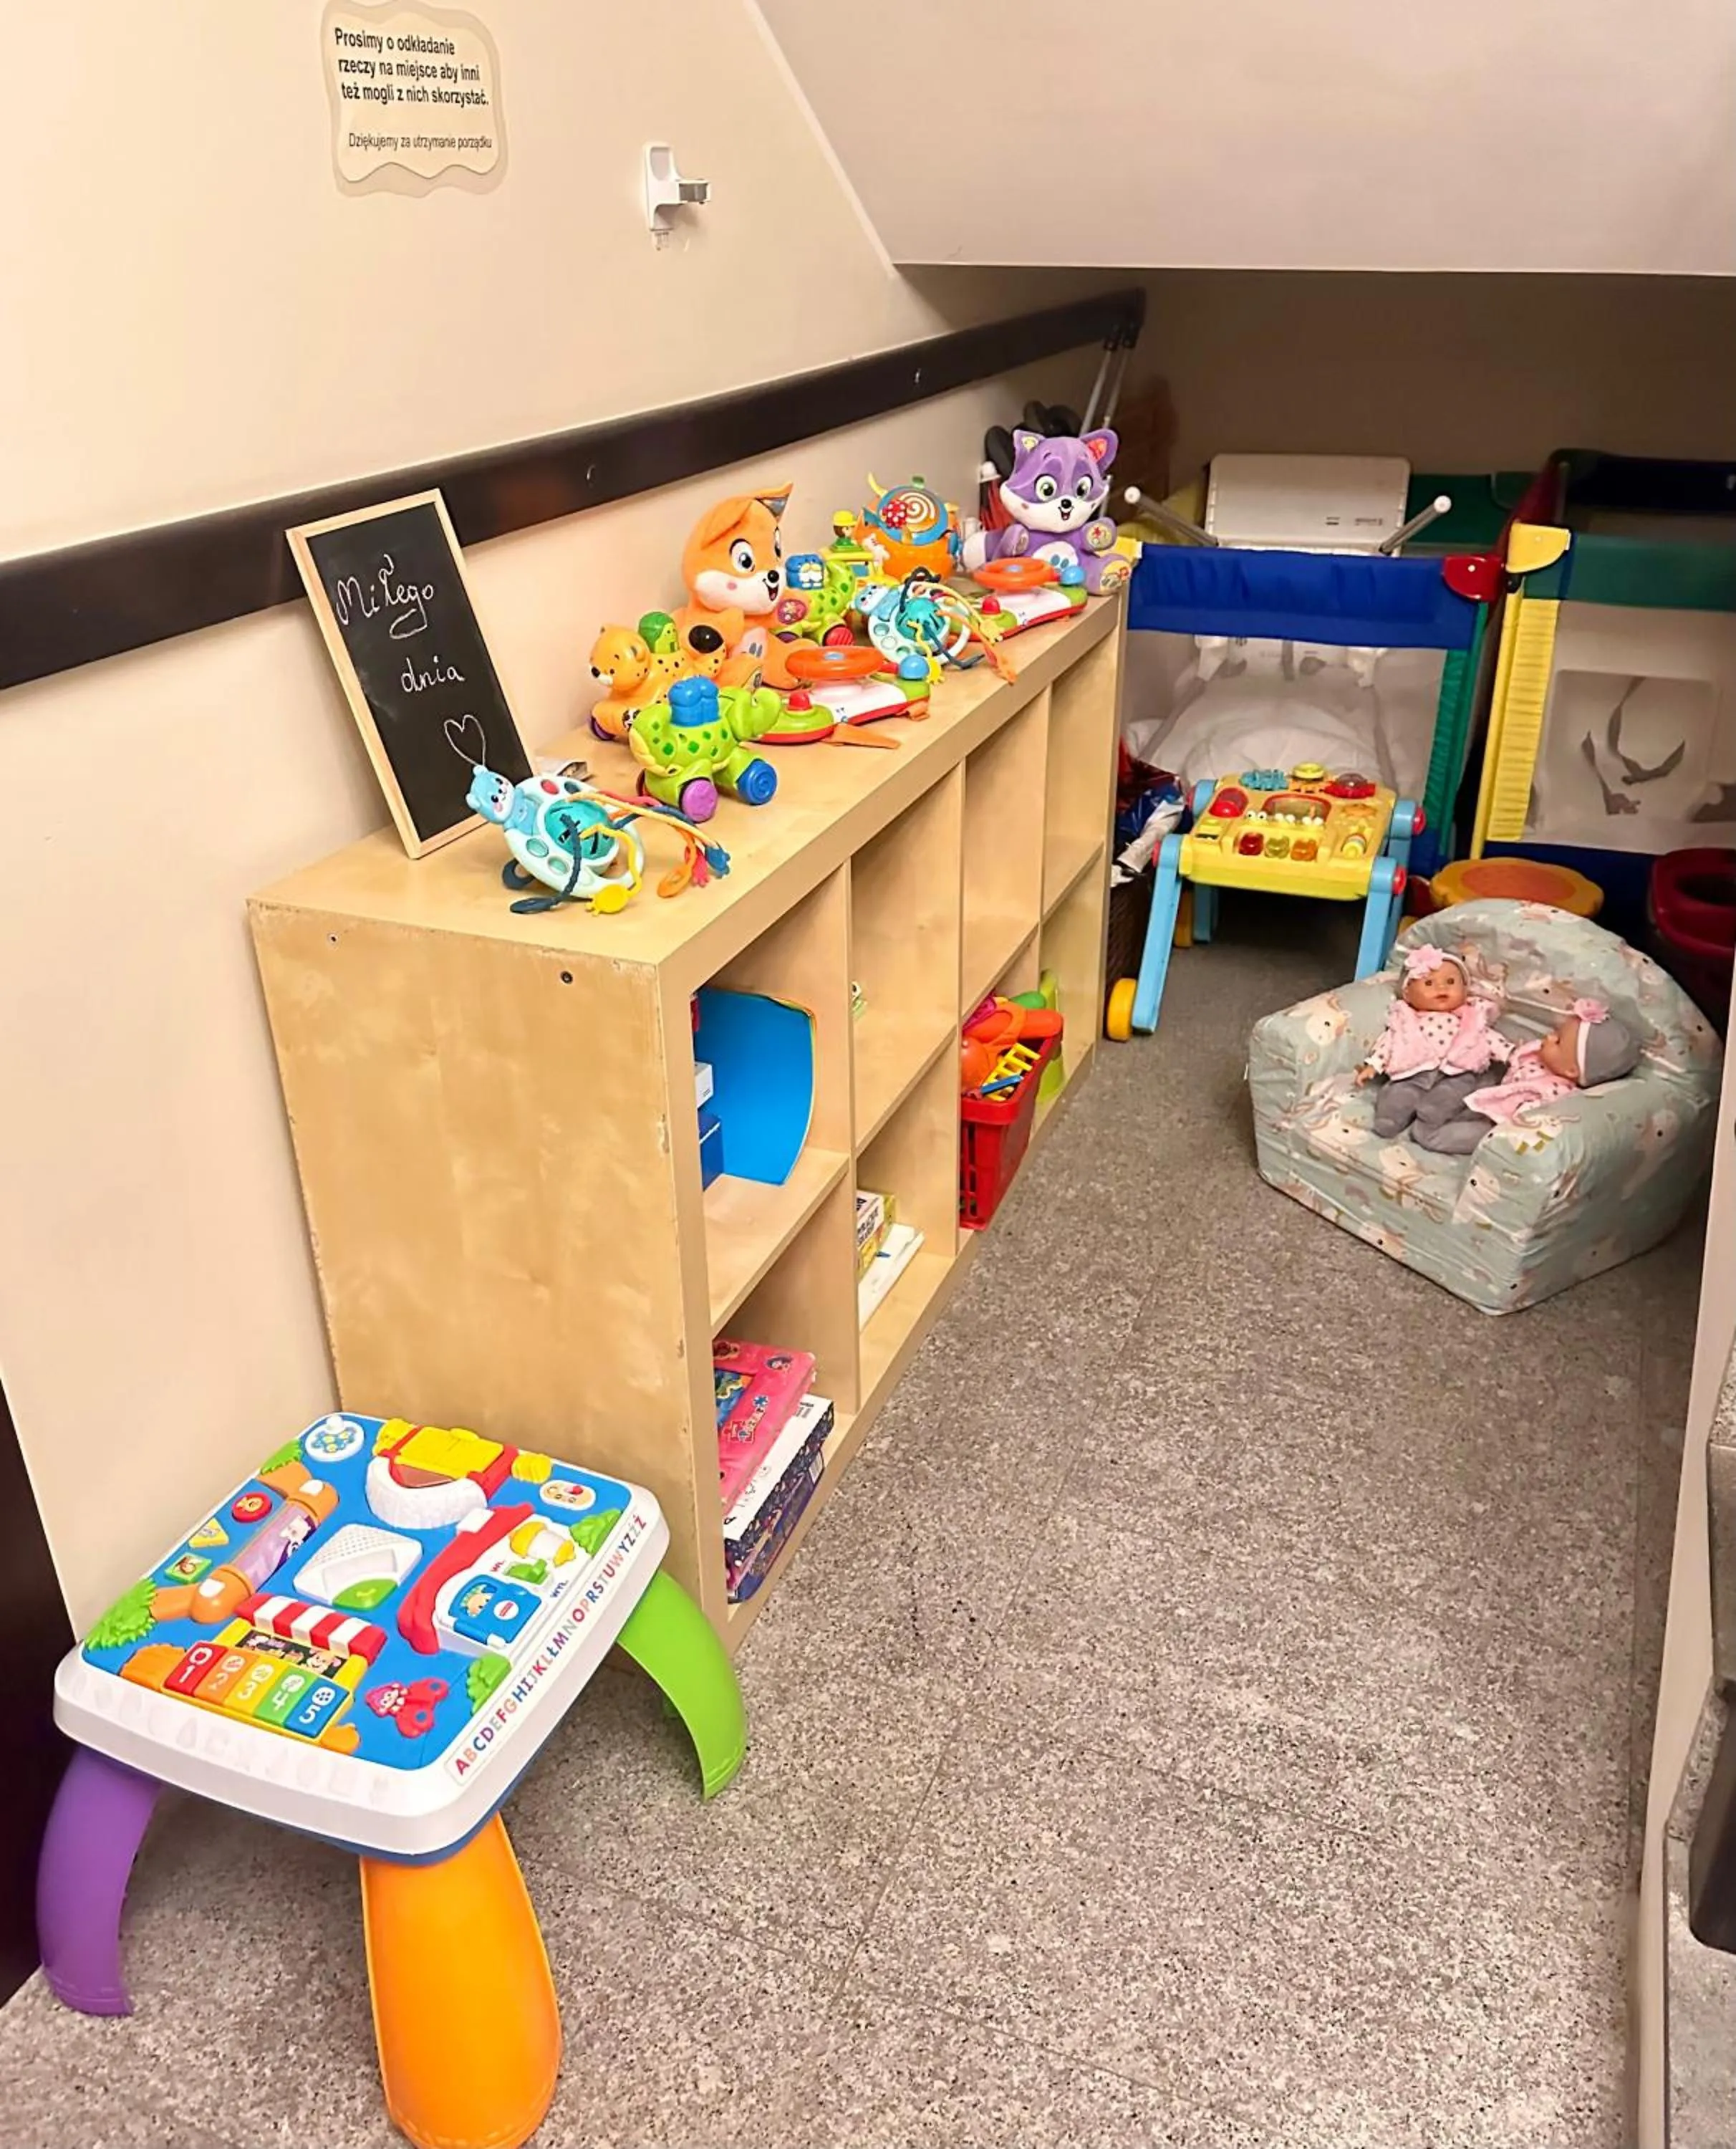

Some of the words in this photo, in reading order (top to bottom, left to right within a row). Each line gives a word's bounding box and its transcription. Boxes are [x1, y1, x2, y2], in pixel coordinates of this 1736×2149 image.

[334, 27, 382, 53] Prosimy
[387, 37, 395, 50] o
[397, 35, 455, 55] odkładanie
[338, 59, 376, 79] rzeczy
[380, 62, 393, 76] na
[396, 60, 438, 81] miejsce
[440, 63, 458, 84] aby
[460, 64, 481, 81] inni
[342, 82, 360, 100] też
[363, 84, 395, 105] mogli
[397, 88, 404, 101] z
[406, 85, 429, 102] nich
[432, 87, 489, 108] skorzystać.
[349, 133, 399, 151] Dziękujemy
[401, 136, 410, 148] za
[413, 134, 456, 151] utrzymanie
[458, 135, 493, 153] porządku
[400, 655, 466, 693] dnia
[179, 1665, 196, 1683] 1
[208, 1672, 229, 1692] 2
[237, 1681, 258, 1701] 3
[271, 1691, 289, 1711] 4
[298, 1704, 322, 1724] 5
